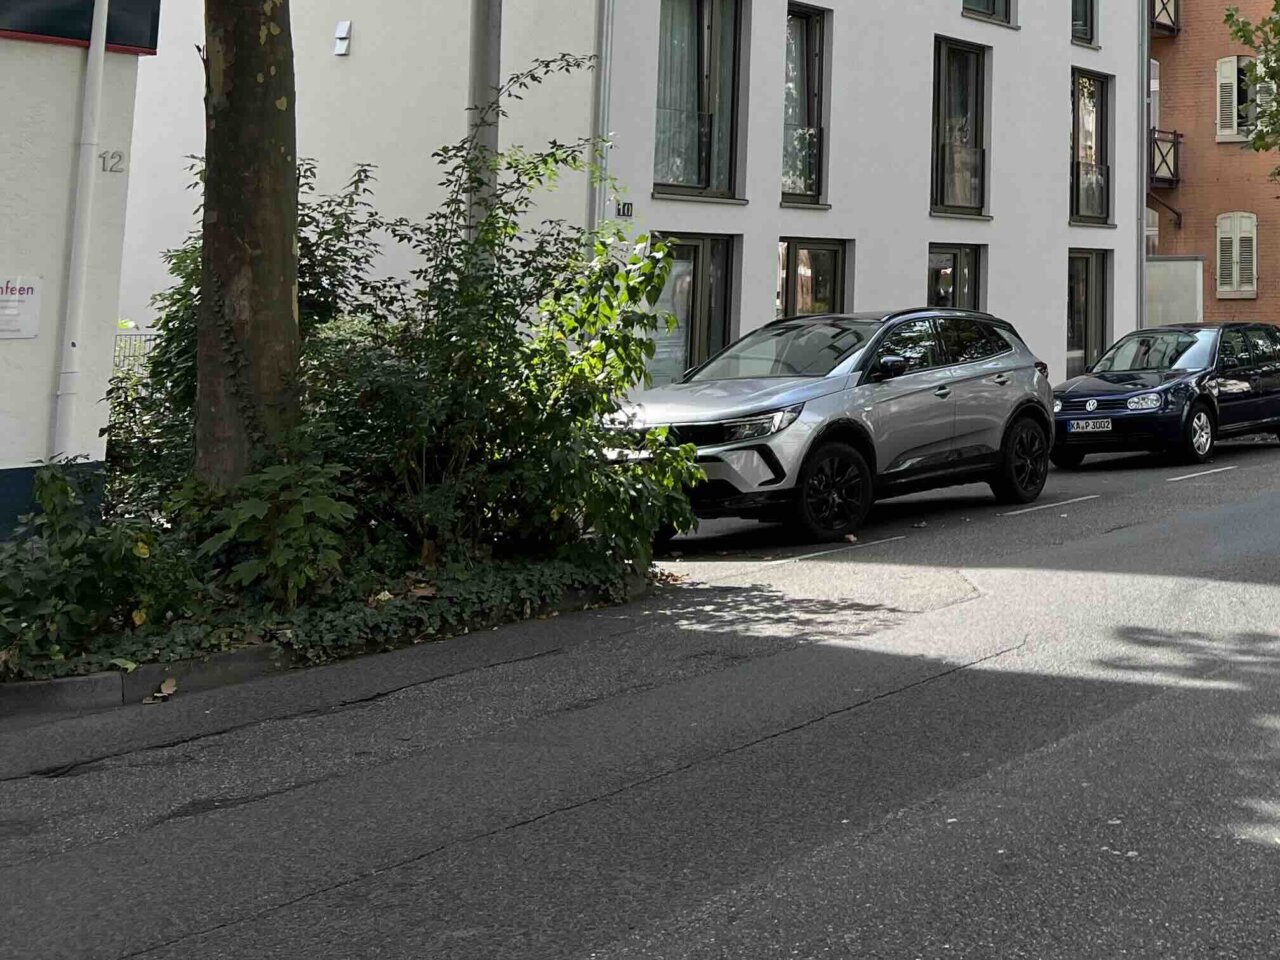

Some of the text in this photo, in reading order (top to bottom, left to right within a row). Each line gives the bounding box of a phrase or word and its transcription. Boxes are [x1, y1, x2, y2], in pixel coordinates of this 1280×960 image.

[98, 151, 125, 173] 12
[618, 203, 632, 216] 10
[1091, 420, 1110, 430] 3002
